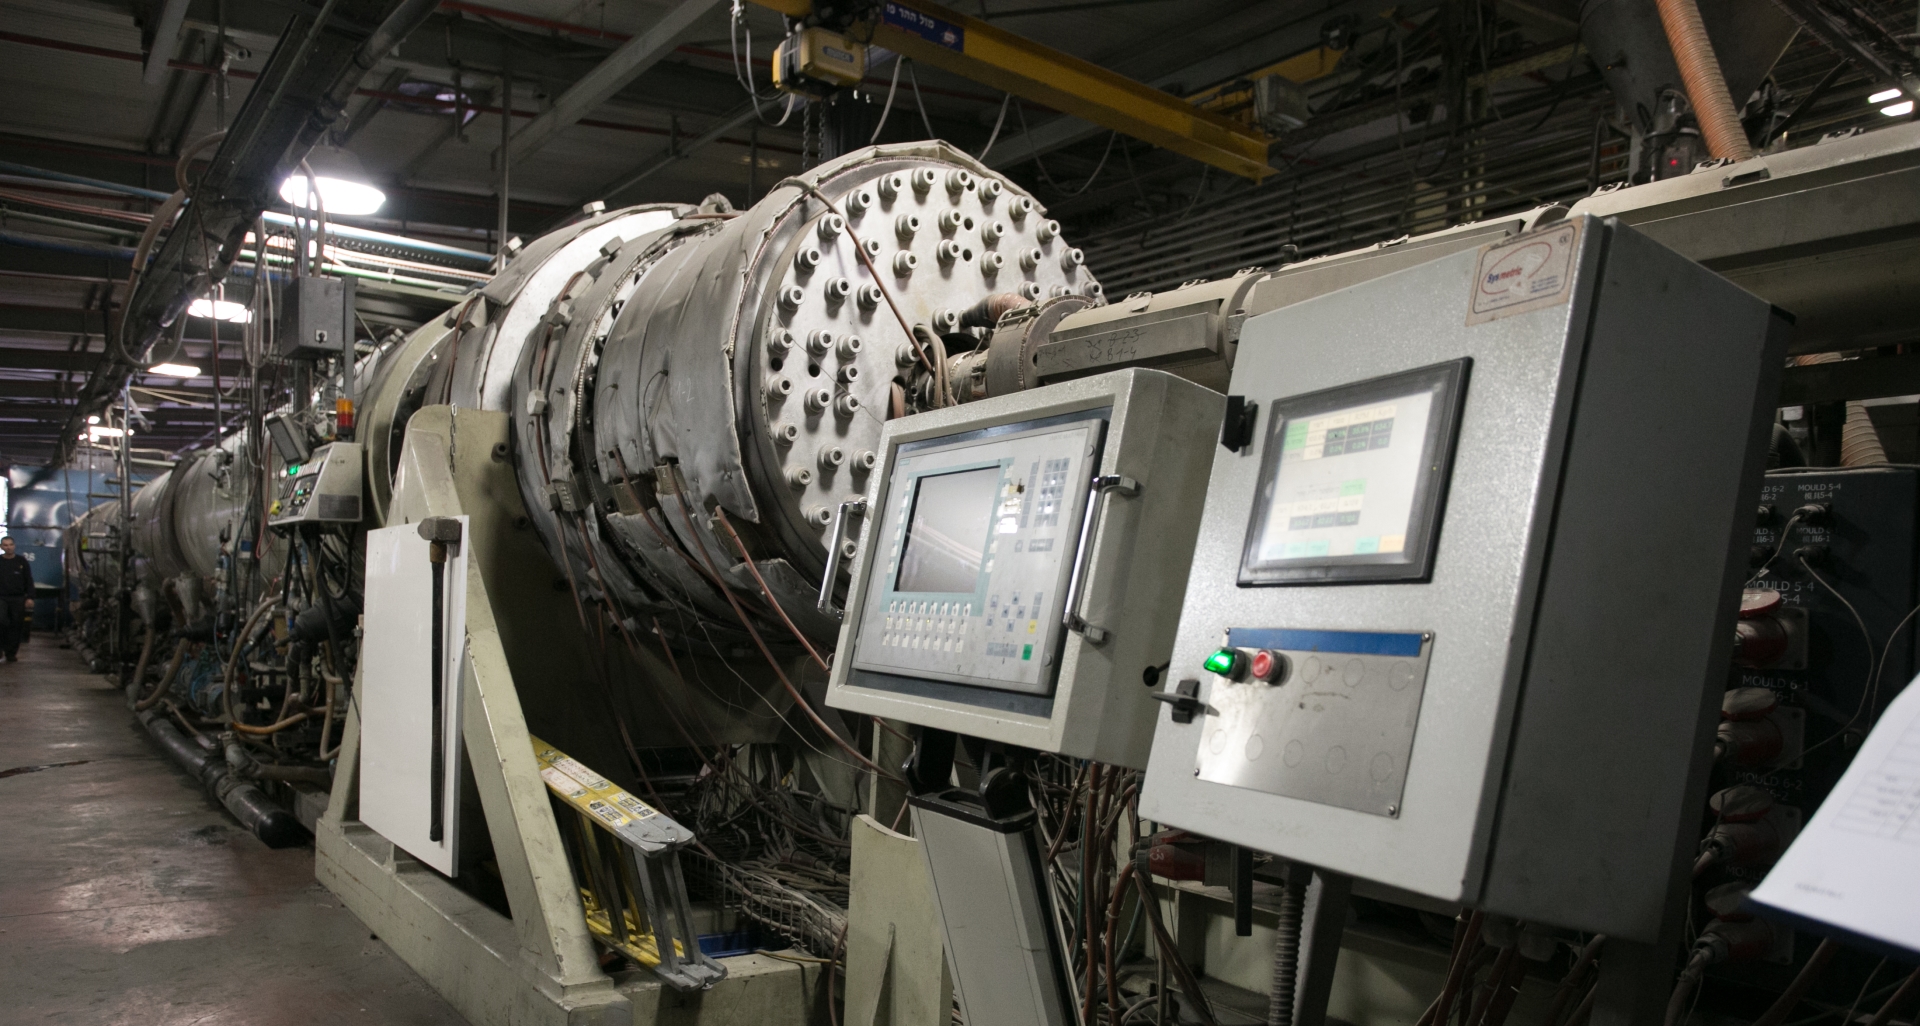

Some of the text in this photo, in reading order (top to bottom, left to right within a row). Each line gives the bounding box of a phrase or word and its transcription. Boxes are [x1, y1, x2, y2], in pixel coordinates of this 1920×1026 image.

[1798, 484, 1827, 492] MOULD
[1796, 527, 1825, 535] MOULD
[1747, 580, 1815, 592] MOULD 5-4
[1742, 675, 1809, 691] MOULD 6-1
[1735, 771, 1803, 791] MOULD 6-2
